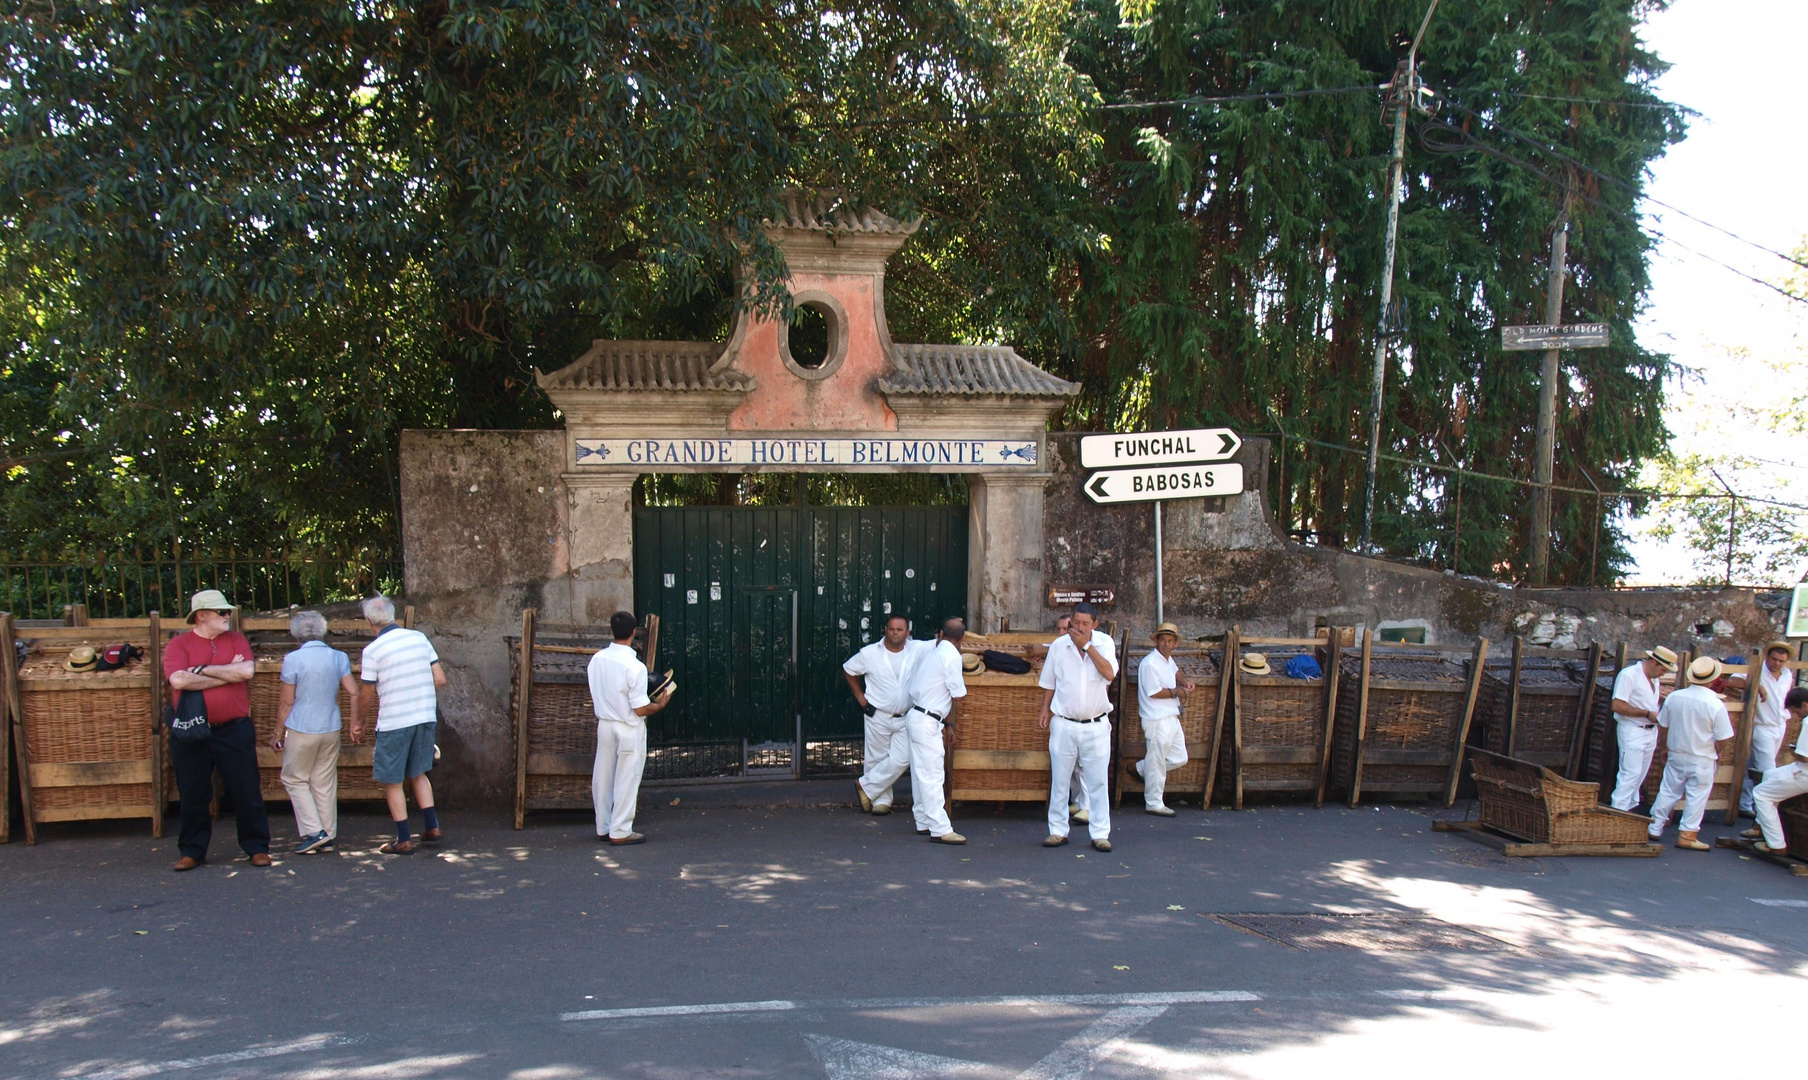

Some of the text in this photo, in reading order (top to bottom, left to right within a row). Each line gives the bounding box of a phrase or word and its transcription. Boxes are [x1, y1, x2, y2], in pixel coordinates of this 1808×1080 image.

[1562, 325, 1604, 334] GARDENS
[627, 440, 985, 464] GRANDE HOTEL BELMONTE
[1114, 436, 1196, 458] FUNCHAL
[1133, 471, 1215, 493] BABOSAS
